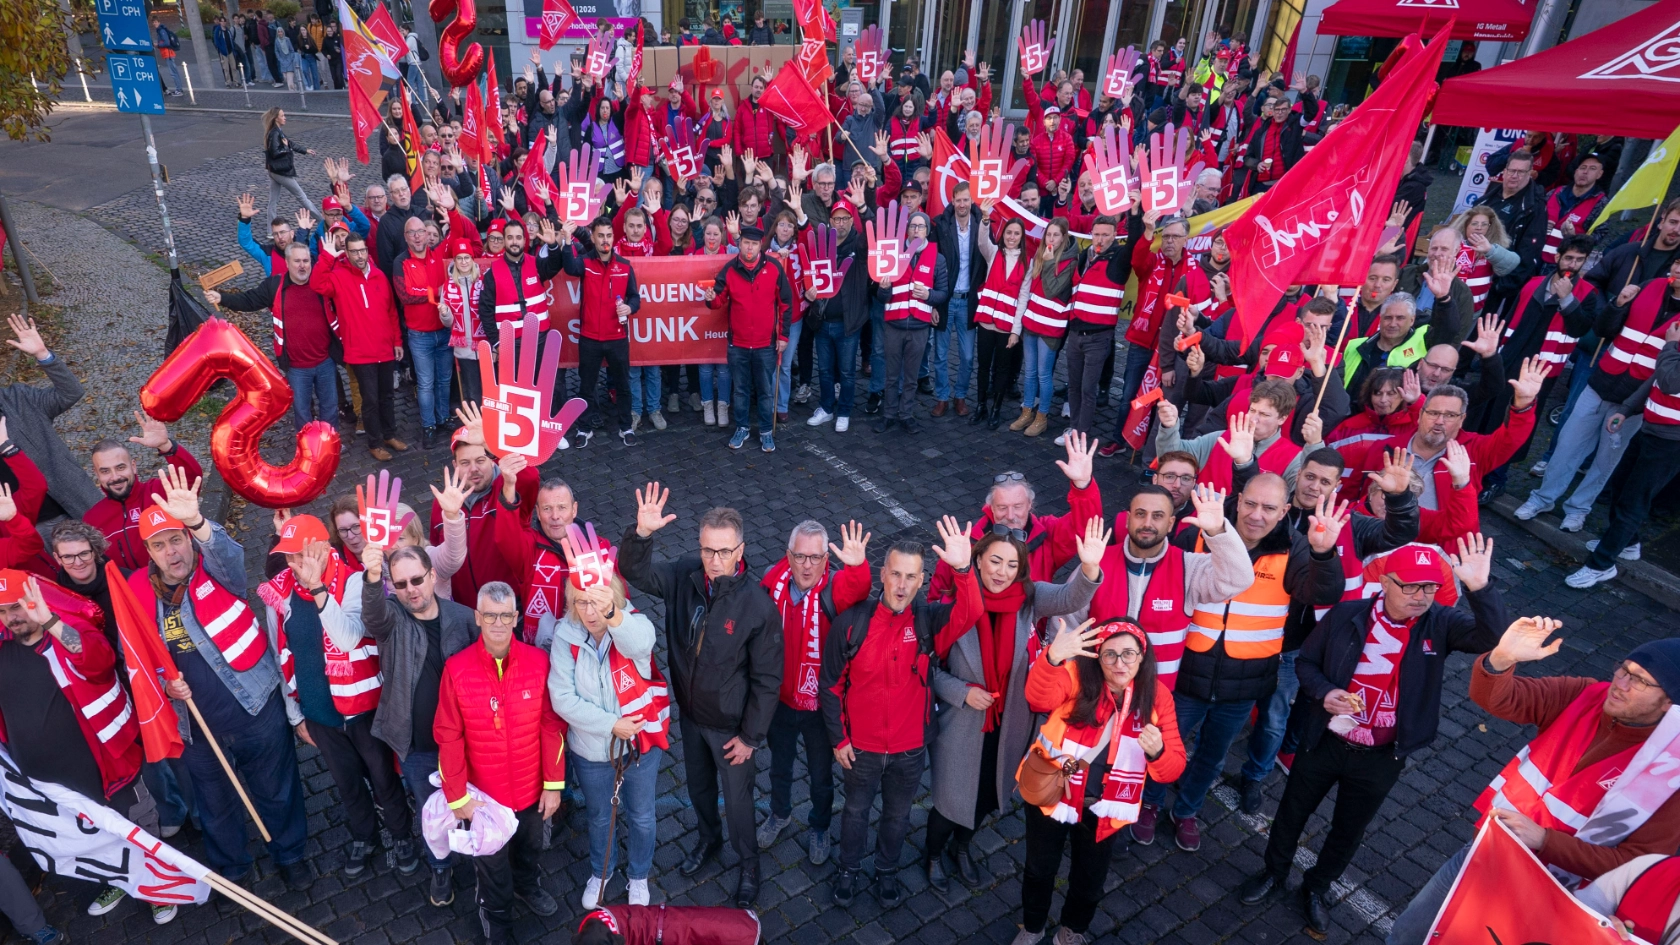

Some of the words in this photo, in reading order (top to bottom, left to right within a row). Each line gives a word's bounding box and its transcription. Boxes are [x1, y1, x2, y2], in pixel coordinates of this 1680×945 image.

[122, 6, 140, 16] CPH
[1485, 23, 1507, 31] Metall
[132, 57, 145, 68] TG
[593, 55, 605, 72] 5
[864, 54, 876, 75] 5
[1028, 46, 1041, 69] 5
[135, 71, 154, 82] CPH
[1111, 72, 1126, 92] 5
[677, 149, 693, 175] 5
[981, 163, 998, 195] 5
[1105, 171, 1126, 206] 5
[1156, 170, 1175, 207] 5
[570, 186, 587, 217] 5
[880, 243, 896, 274] 5
[814, 263, 831, 291] 5
[504, 391, 535, 448] 5
[370, 511, 387, 542] 5
[580, 556, 600, 587] 5
